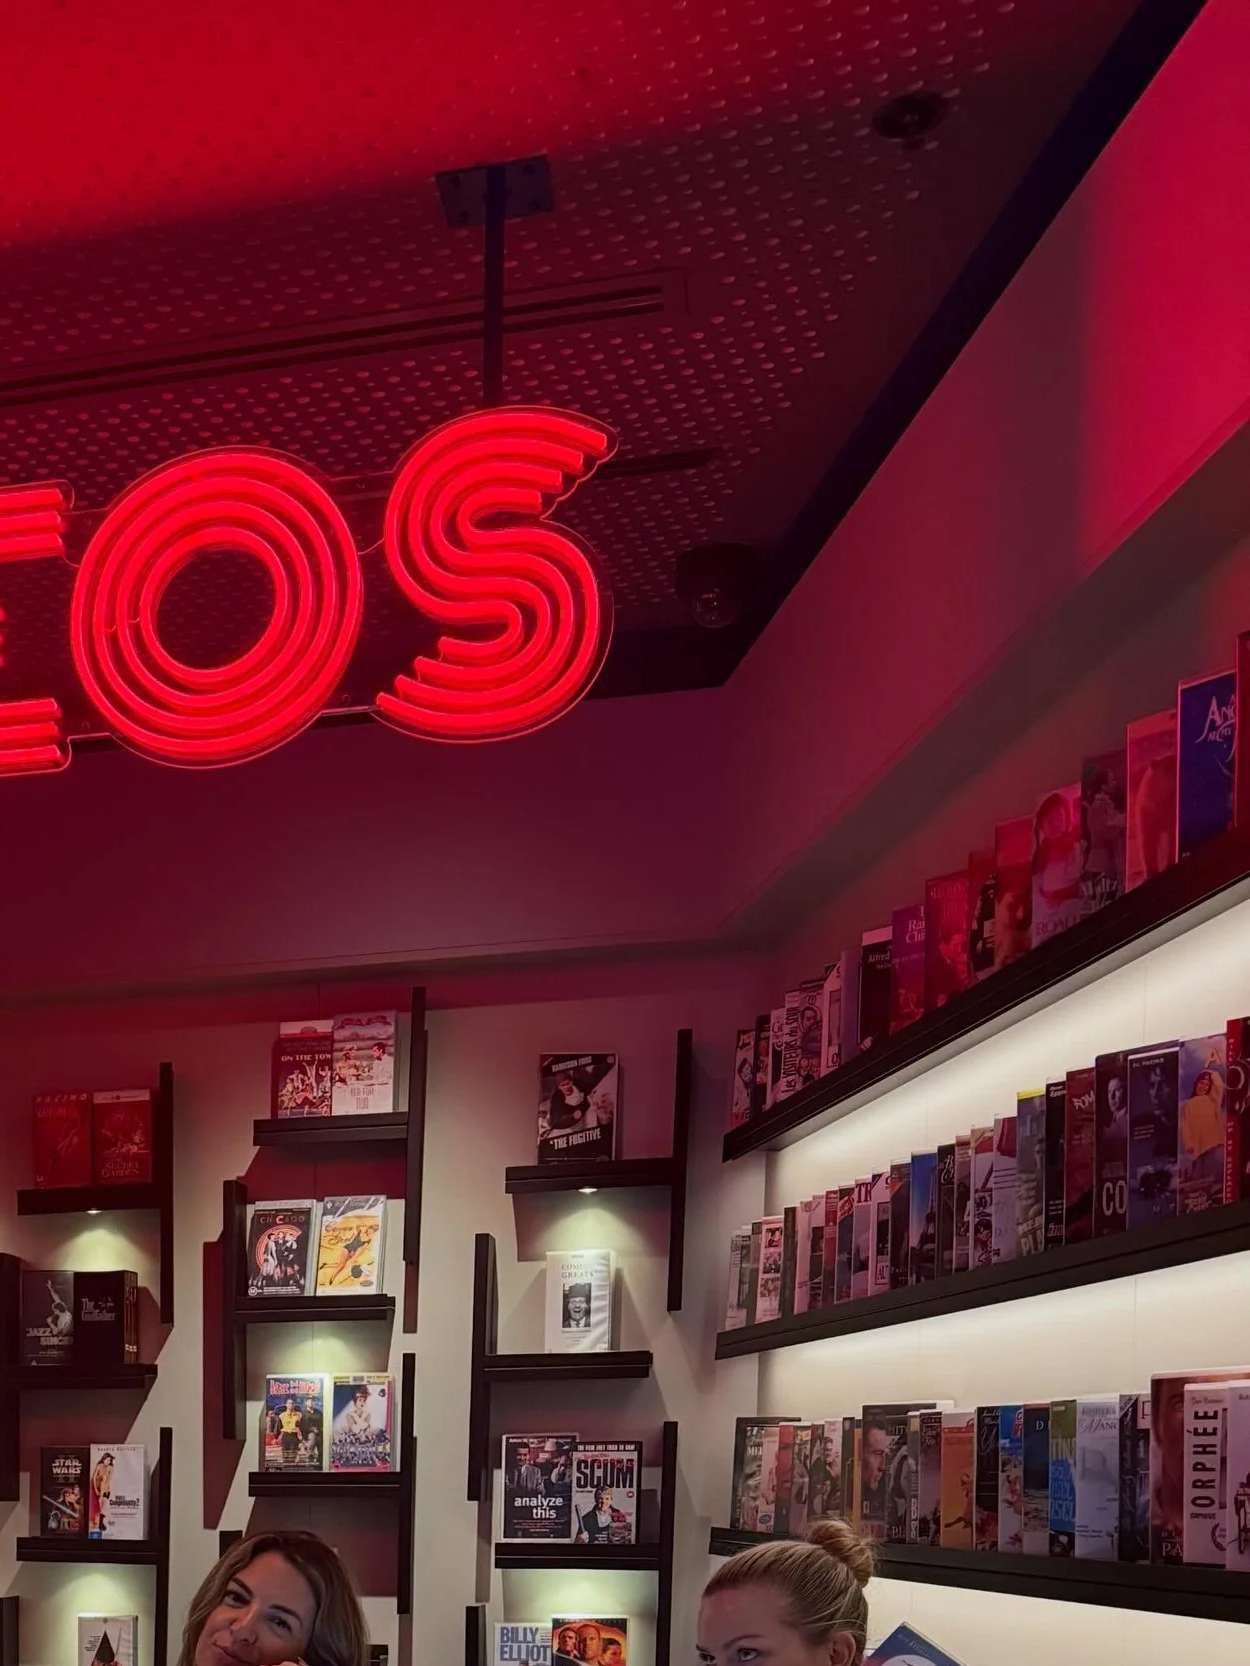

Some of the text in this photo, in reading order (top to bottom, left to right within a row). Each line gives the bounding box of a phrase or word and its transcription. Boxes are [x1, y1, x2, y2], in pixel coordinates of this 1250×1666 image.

[868, 951, 890, 964] Alfred
[35, 1093, 88, 1103] PACINO
[568, 1127, 602, 1146] FUGITIVE
[260, 1214, 306, 1225] CHICAGO
[52, 1458, 82, 1467] STAR
[1186, 1408, 1219, 1509] ORPHÉE
[52, 1466, 82, 1475] WARS
[575, 1458, 635, 1489] SCUM
[514, 1494, 564, 1509] analyze
[532, 1507, 557, 1520] this
[500, 1626, 540, 1644] BILLY
[500, 1644, 550, 1662] ELLIOT
